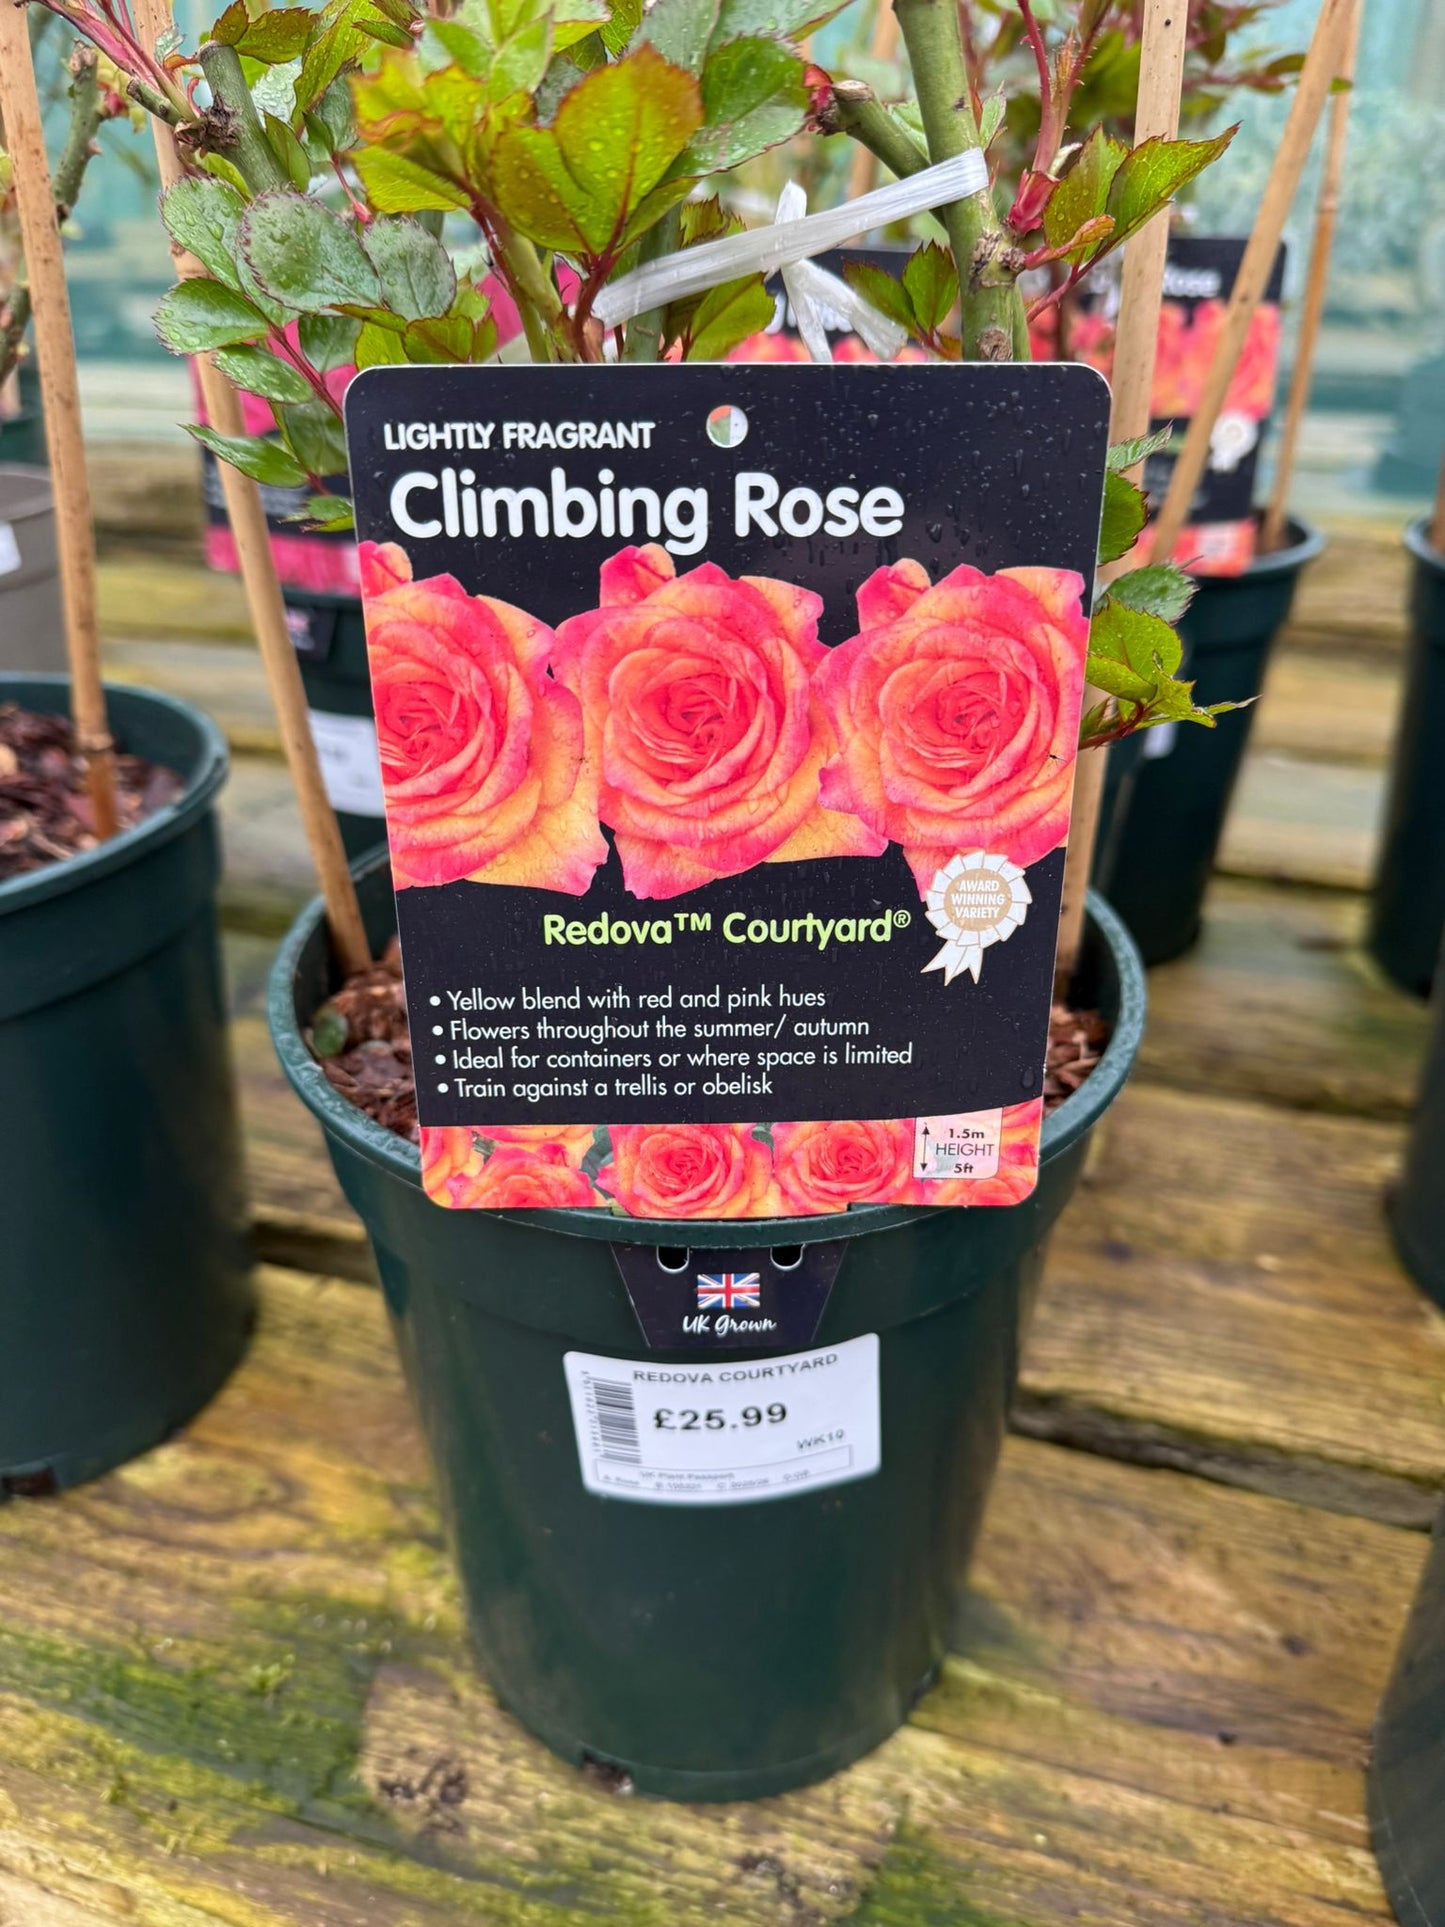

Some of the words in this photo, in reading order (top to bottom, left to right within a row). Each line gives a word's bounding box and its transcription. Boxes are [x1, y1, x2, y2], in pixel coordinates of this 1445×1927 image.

[383, 422, 497, 450] LIGHTLY
[502, 421, 656, 449] FRAGRANT
[389, 466, 711, 556] Climbing
[733, 472, 906, 538] Rose
[951, 893, 1005, 906] WINNING
[959, 880, 1000, 892] AWARD
[955, 906, 1000, 919] VARIETY
[446, 986, 517, 1012] Yellow
[521, 985, 581, 1010] blend
[587, 984, 632, 1009] with
[638, 984, 673, 1009] red
[679, 983, 720, 1009] and
[727, 983, 773, 1015] pink
[778, 982, 827, 1007] hues
[449, 1017, 530, 1041] Flowers
[536, 1015, 650, 1045] throughout
[655, 1014, 688, 1039] the
[793, 1017, 871, 1037] autumn
[452, 1046, 504, 1070] Ideal
[510, 1045, 541, 1069] for
[545, 1047, 653, 1069] containers
[657, 1052, 682, 1068] or
[686, 1043, 751, 1067] where
[756, 1050, 817, 1072] space
[822, 1045, 839, 1065] is
[844, 1041, 914, 1065] limited
[453, 1077, 506, 1098] Train
[512, 1076, 589, 1103] against
[593, 1082, 609, 1097] a
[614, 1073, 669, 1096] trellis
[673, 1081, 697, 1096] or
[701, 1071, 774, 1096] obelisk
[949, 1128, 985, 1139] 1.5m
[936, 1143, 994, 1156] HEIGHT
[954, 1163, 973, 1173] 5ft
[682, 1315, 711, 1334] UK
[714, 1315, 777, 1337] Grown
[633, 1368, 713, 1385] REDOVA
[718, 1353, 838, 1384] COURTYARD
[653, 1401, 789, 1432] £25.99
